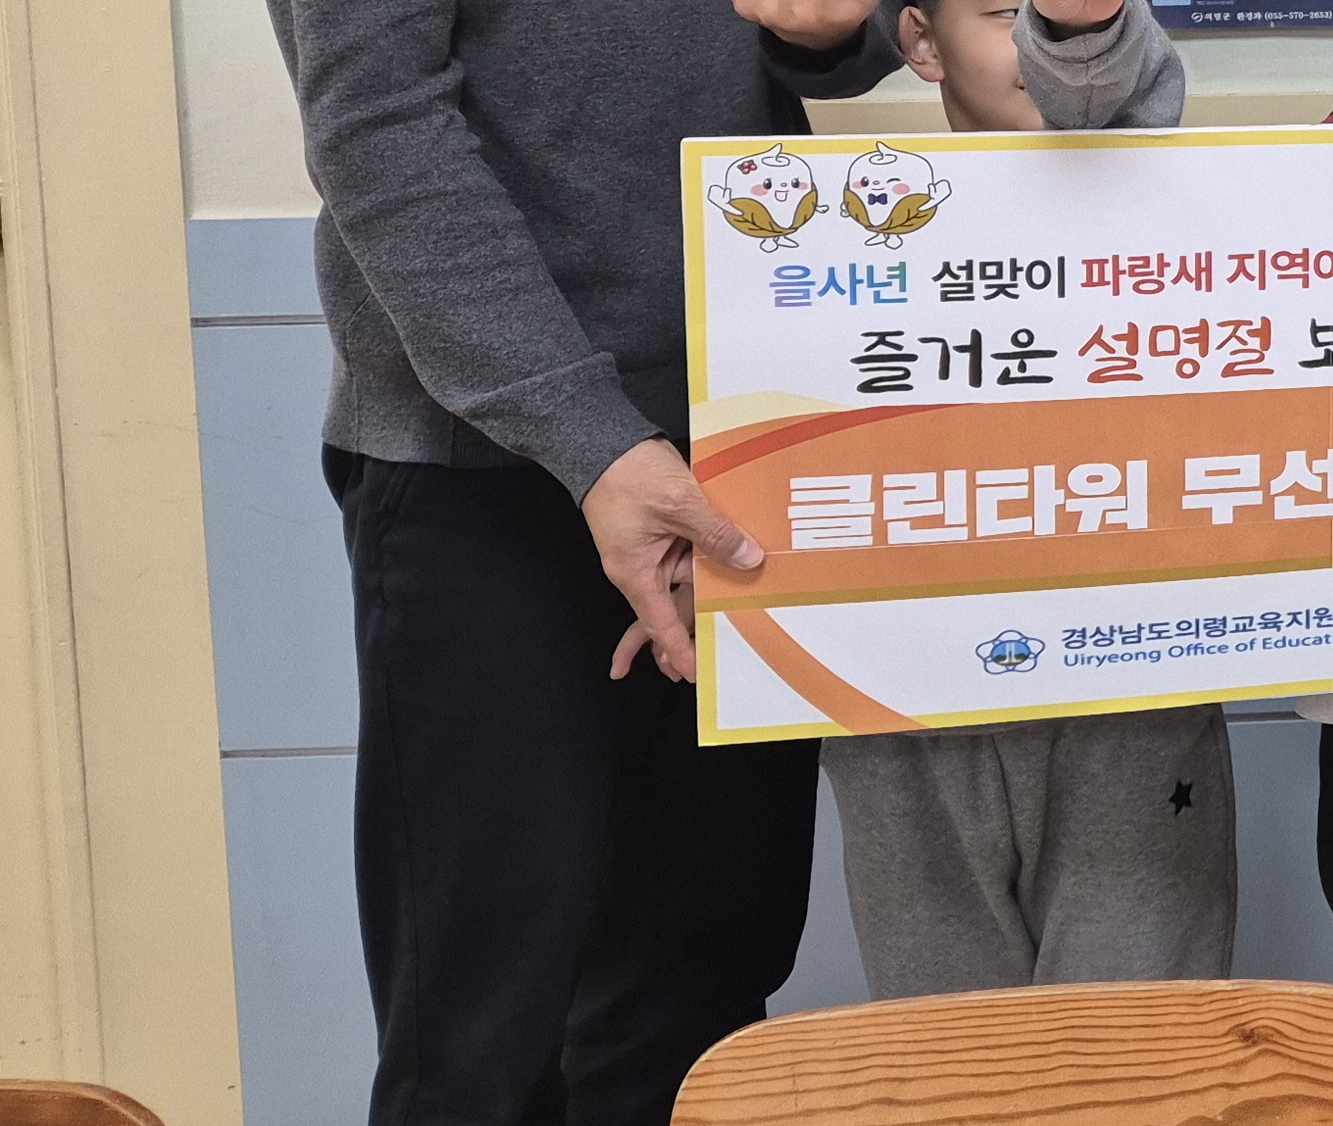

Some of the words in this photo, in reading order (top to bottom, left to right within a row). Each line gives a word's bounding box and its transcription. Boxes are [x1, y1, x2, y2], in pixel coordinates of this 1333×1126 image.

[769, 261, 910, 309] 을사년
[932, 255, 1066, 301] 설맞이
[1081, 252, 1212, 297] 파랑새
[851, 327, 1057, 395] 즐거운
[1077, 319, 1274, 383] 설명절
[788, 459, 1149, 552] 클린타워
[1064, 646, 1161, 670] Uiryeong
[1167, 642, 1230, 662] Office
[1235, 639, 1255, 655] of
